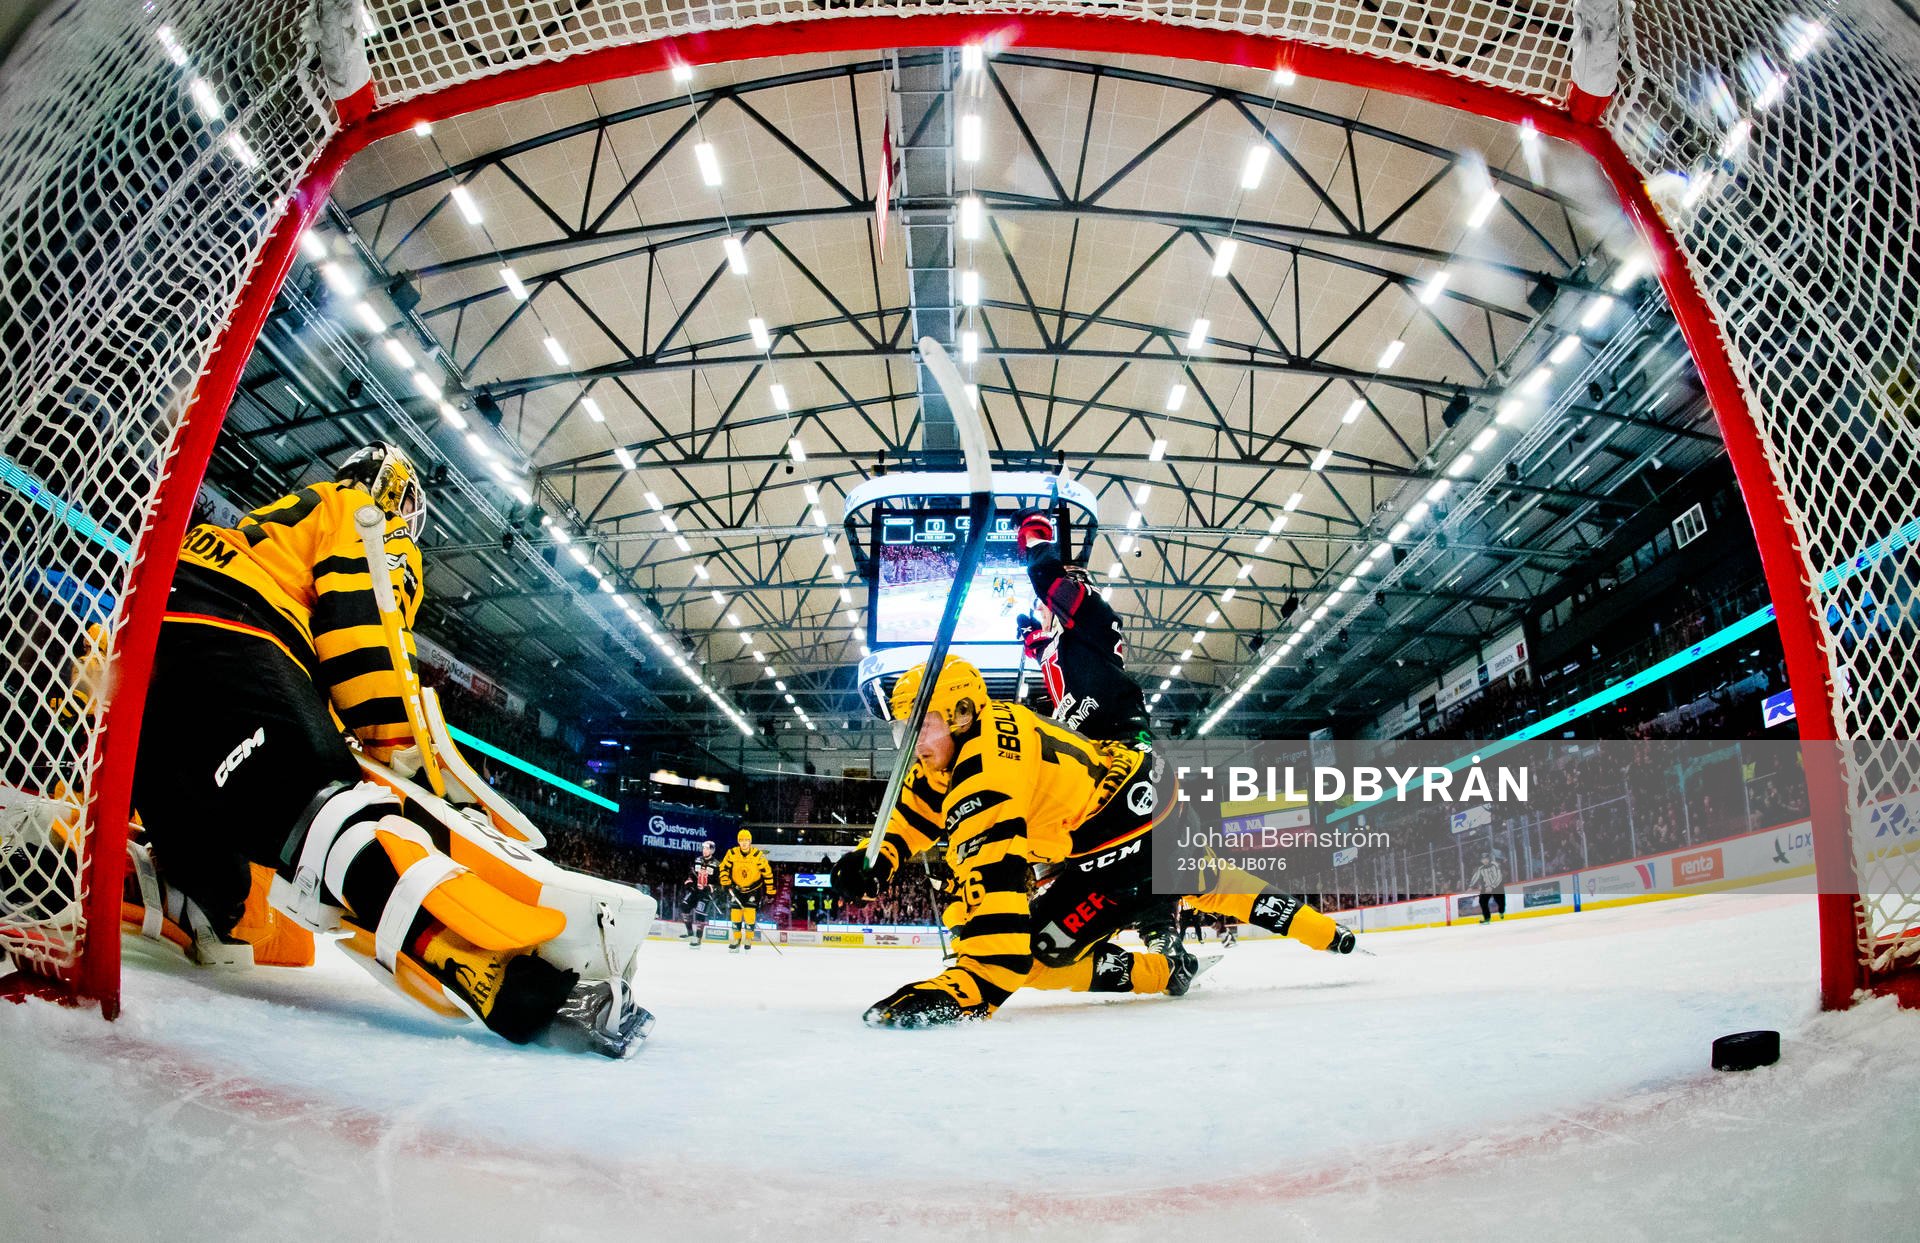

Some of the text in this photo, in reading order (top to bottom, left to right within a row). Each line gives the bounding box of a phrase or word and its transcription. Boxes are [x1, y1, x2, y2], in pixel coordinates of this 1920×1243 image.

[183, 527, 238, 569] RÖM
[214, 726, 265, 788] CCM
[648, 815, 708, 838] Gustavsvik
[642, 834, 704, 853] FAMILJELÄKTA
[1078, 839, 1142, 872] CCM
[1680, 855, 1714, 876] renta
